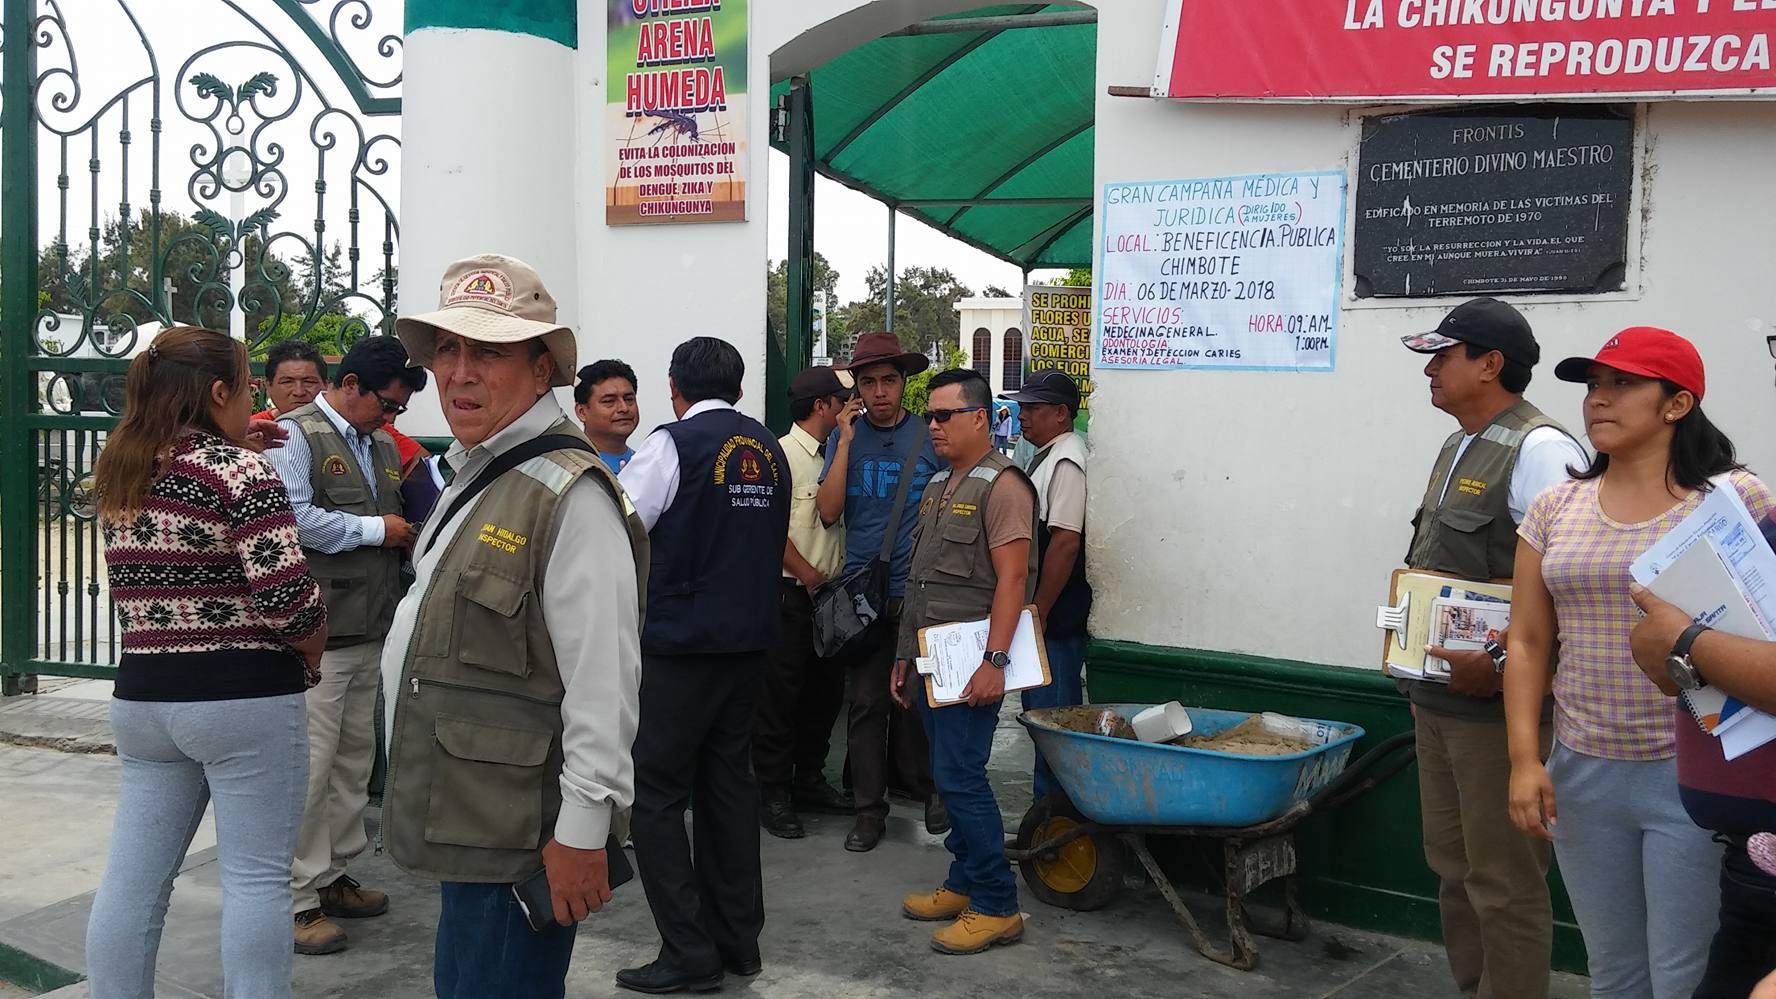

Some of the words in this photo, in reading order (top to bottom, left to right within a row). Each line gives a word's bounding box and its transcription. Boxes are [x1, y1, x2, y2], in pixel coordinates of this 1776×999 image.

[1344, 0, 1385, 30] LA
[637, 18, 715, 64] ARENA
[1430, 44, 1477, 79] SE
[1488, 33, 1770, 77] REPRODUZCA
[626, 67, 726, 113] HUMEDA
[1452, 123, 1525, 144] FRONTIS
[619, 147, 645, 160] EVITA
[648, 147, 659, 159] LA
[662, 142, 735, 158] COLONIZACION
[620, 167, 631, 179] DE
[634, 166, 652, 178] LOS
[654, 164, 714, 177] MOSQUITOS
[717, 161, 734, 174] DEL
[1370, 156, 1469, 183] CEMENTERIO
[1475, 152, 1527, 174] DIVINO
[1533, 145, 1614, 168] MAESTRO
[640, 183, 680, 196] DENGUE,
[682, 182, 704, 194] ZIKA
[707, 181, 713, 193] Y
[1107, 185, 1154, 204] GRAN
[1158, 180, 1233, 203] CAMPAÑA
[1242, 175, 1298, 199] MÉDICA
[1311, 176, 1320, 199] Y
[640, 200, 712, 215] CHIKUNGUNYA
[1366, 206, 1421, 219] EDIFICADO
[1424, 206, 1437, 215] EN
[1440, 202, 1489, 214] MEMORIA
[1493, 201, 1507, 210] DE
[1511, 199, 1531, 209] LAS
[1535, 194, 1588, 207] VICTIMAS
[1592, 193, 1613, 204] DEL
[1154, 206, 1235, 227] JURIDICA
[1429, 215, 1495, 227] TERREMOTO
[1497, 213, 1513, 223] DE
[1516, 212, 1542, 222] 1970
[1106, 232, 1160, 253] LOCAL:
[1434, 240, 1501, 251] RESURRECCION
[1160, 255, 1241, 276] CHIMBOTE
[1387, 254, 1409, 262] CREE
[1437, 251, 1471, 260] AUNQUE
[1032, 293, 1048, 307] SE
[1137, 282, 1156, 301] 06
[1160, 281, 1176, 300] DE
[1032, 310, 1080, 325] FLORES
[1031, 327, 1069, 345] AGUA,
[1073, 328, 1091, 342] SE
[1101, 348, 1138, 357] EXAMEN
[1146, 349, 1200, 357] DETECCION
[1205, 349, 1241, 358] CARIES
[1101, 356, 1147, 365] ASESORIA
[733, 435, 764, 453] PROVINCIAL
[728, 484, 741, 494] SUB
[766, 486, 774, 495] DE
[731, 497, 750, 507] SALUD
[496, 527, 527, 546] HIDALGO
